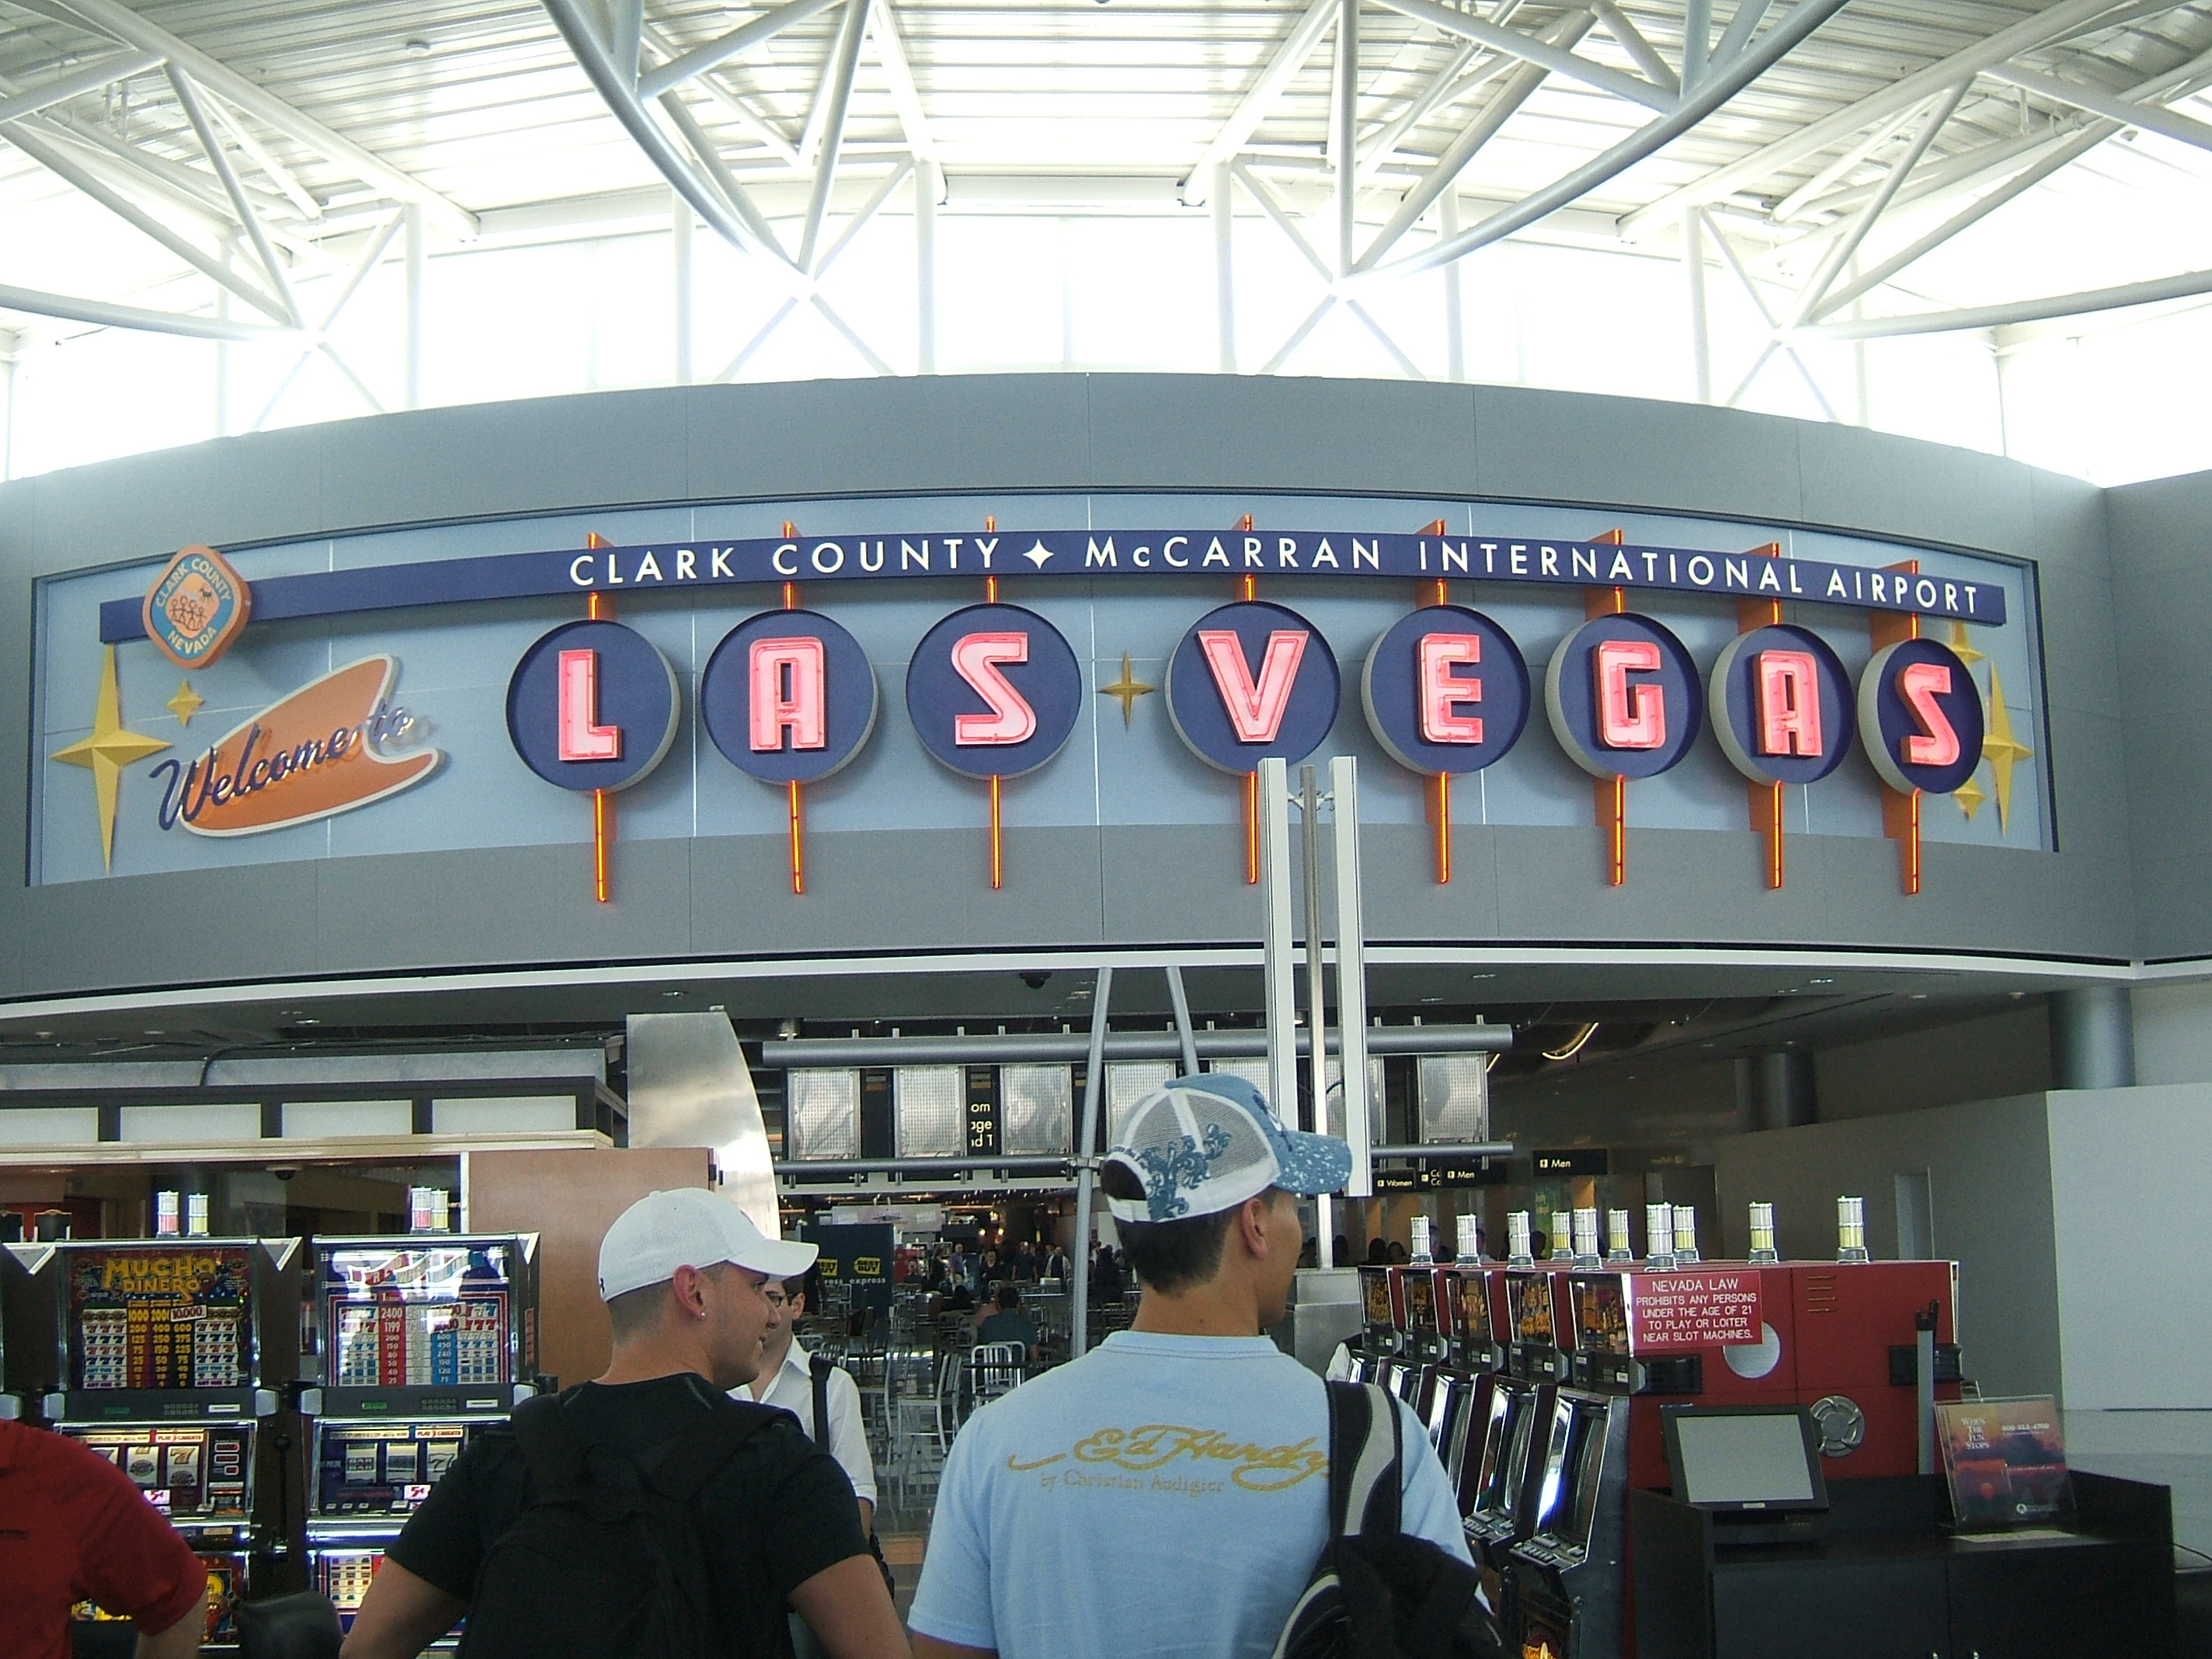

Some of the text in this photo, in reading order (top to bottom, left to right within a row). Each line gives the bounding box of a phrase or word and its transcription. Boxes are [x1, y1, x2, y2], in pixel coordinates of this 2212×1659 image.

[570, 535, 1977, 614] CLARK COUNTY McCARRAN INTERNATIONAL AIRPORT
[156, 558, 231, 607] CLARK COUNTY
[168, 627, 217, 654] NEVADA
[558, 630, 1960, 766] LAS VEGAS
[149, 697, 415, 831] Welcome to
[1551, 1160, 1571, 1168] Men
[1386, 1179, 1413, 1188] Women
[101, 1255, 216, 1289] MUCHO
[123, 1276, 202, 1298] DINERO
[1652, 1278, 1738, 1292] NEVADA LAW
[1636, 1292, 1757, 1307] PROHIBITS ANY PERSONS
[381, 1307, 403, 1319] 2400
[1643, 1306, 1752, 1318] UNDER THE AGE OF 21
[129, 1324, 147, 1334] 200
[152, 1323, 170, 1333] 400
[173, 1323, 192, 1332] 600
[384, 1322, 401, 1333] 1199
[1649, 1317, 1748, 1330] TO PLAY OR LOITER
[1643, 1330, 1753, 1343] NEAR SLOT MACHINES.
[1074, 1424, 1330, 1491] Ed Hardy
[1041, 1469, 1225, 1497] by Christian Audigier
